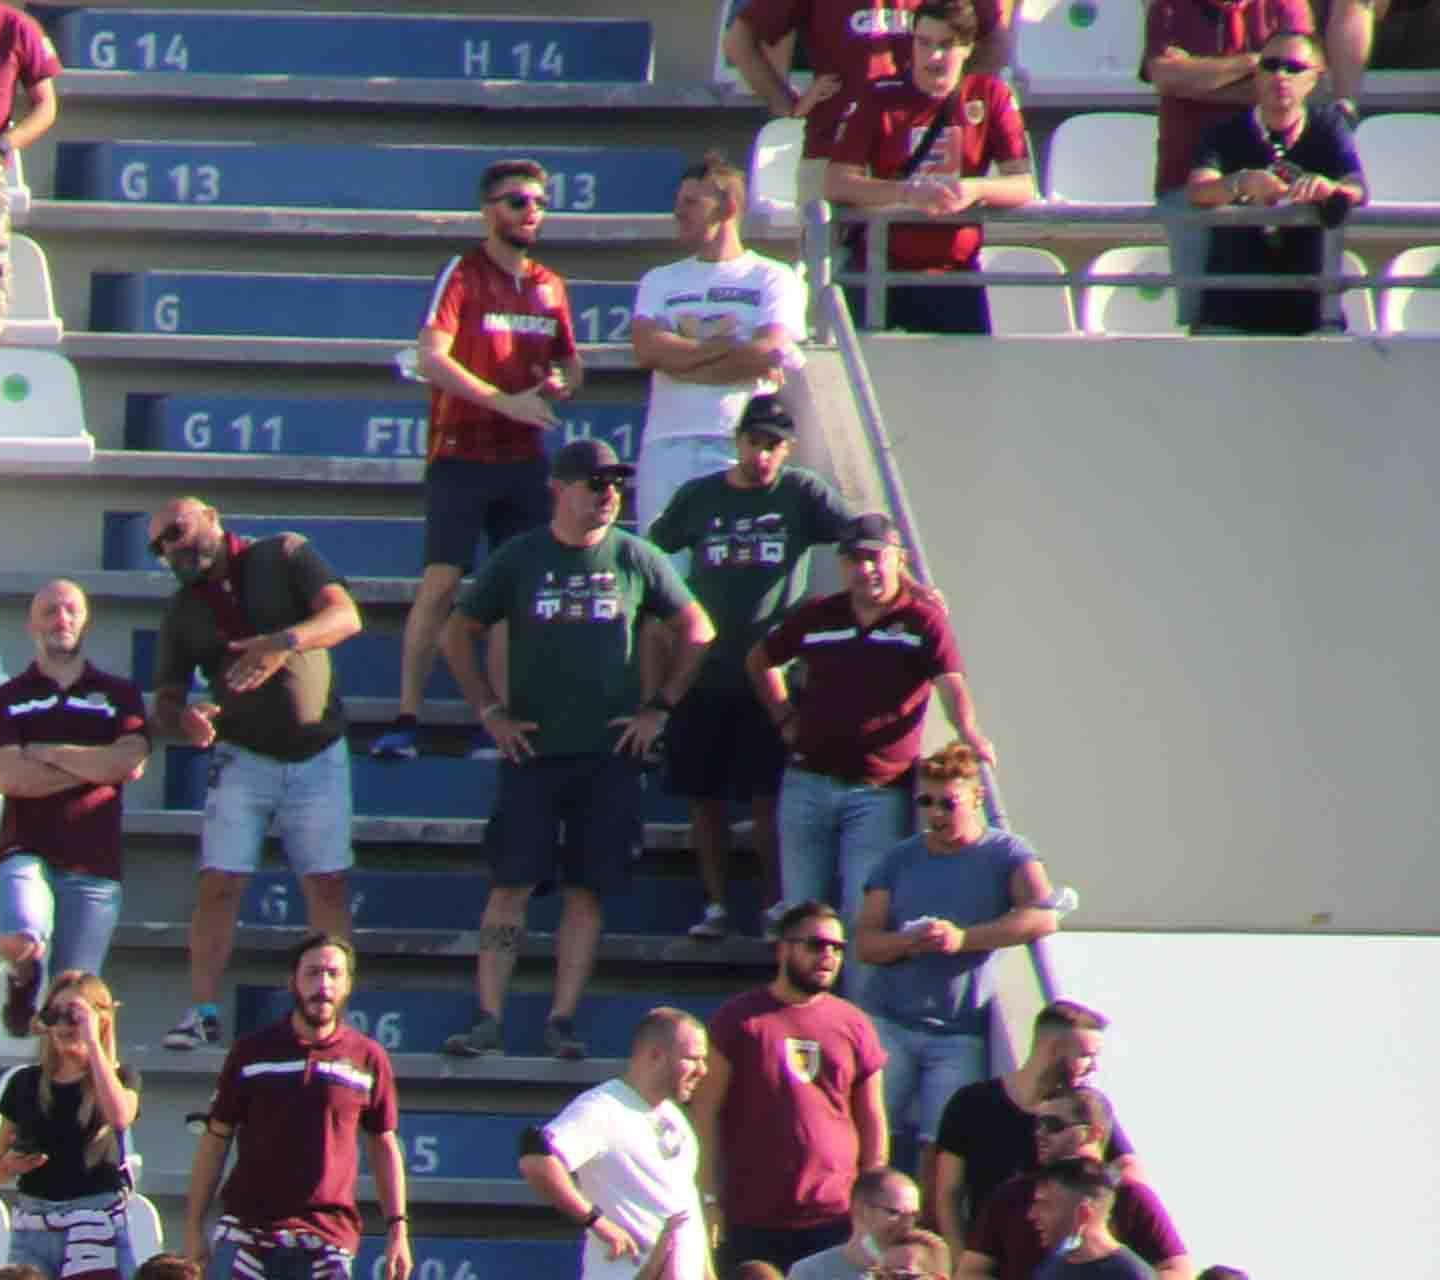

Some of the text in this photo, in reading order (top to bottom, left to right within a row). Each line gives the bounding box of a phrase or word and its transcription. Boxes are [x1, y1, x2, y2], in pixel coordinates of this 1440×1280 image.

[90, 31, 189, 72] G 14
[463, 41, 564, 77] H 14
[121, 163, 220, 203] G 13
[550, 174, 597, 210] 13
[154, 295, 178, 331] G
[580, 306, 632, 344] 12
[183, 413, 283, 453] G 11
